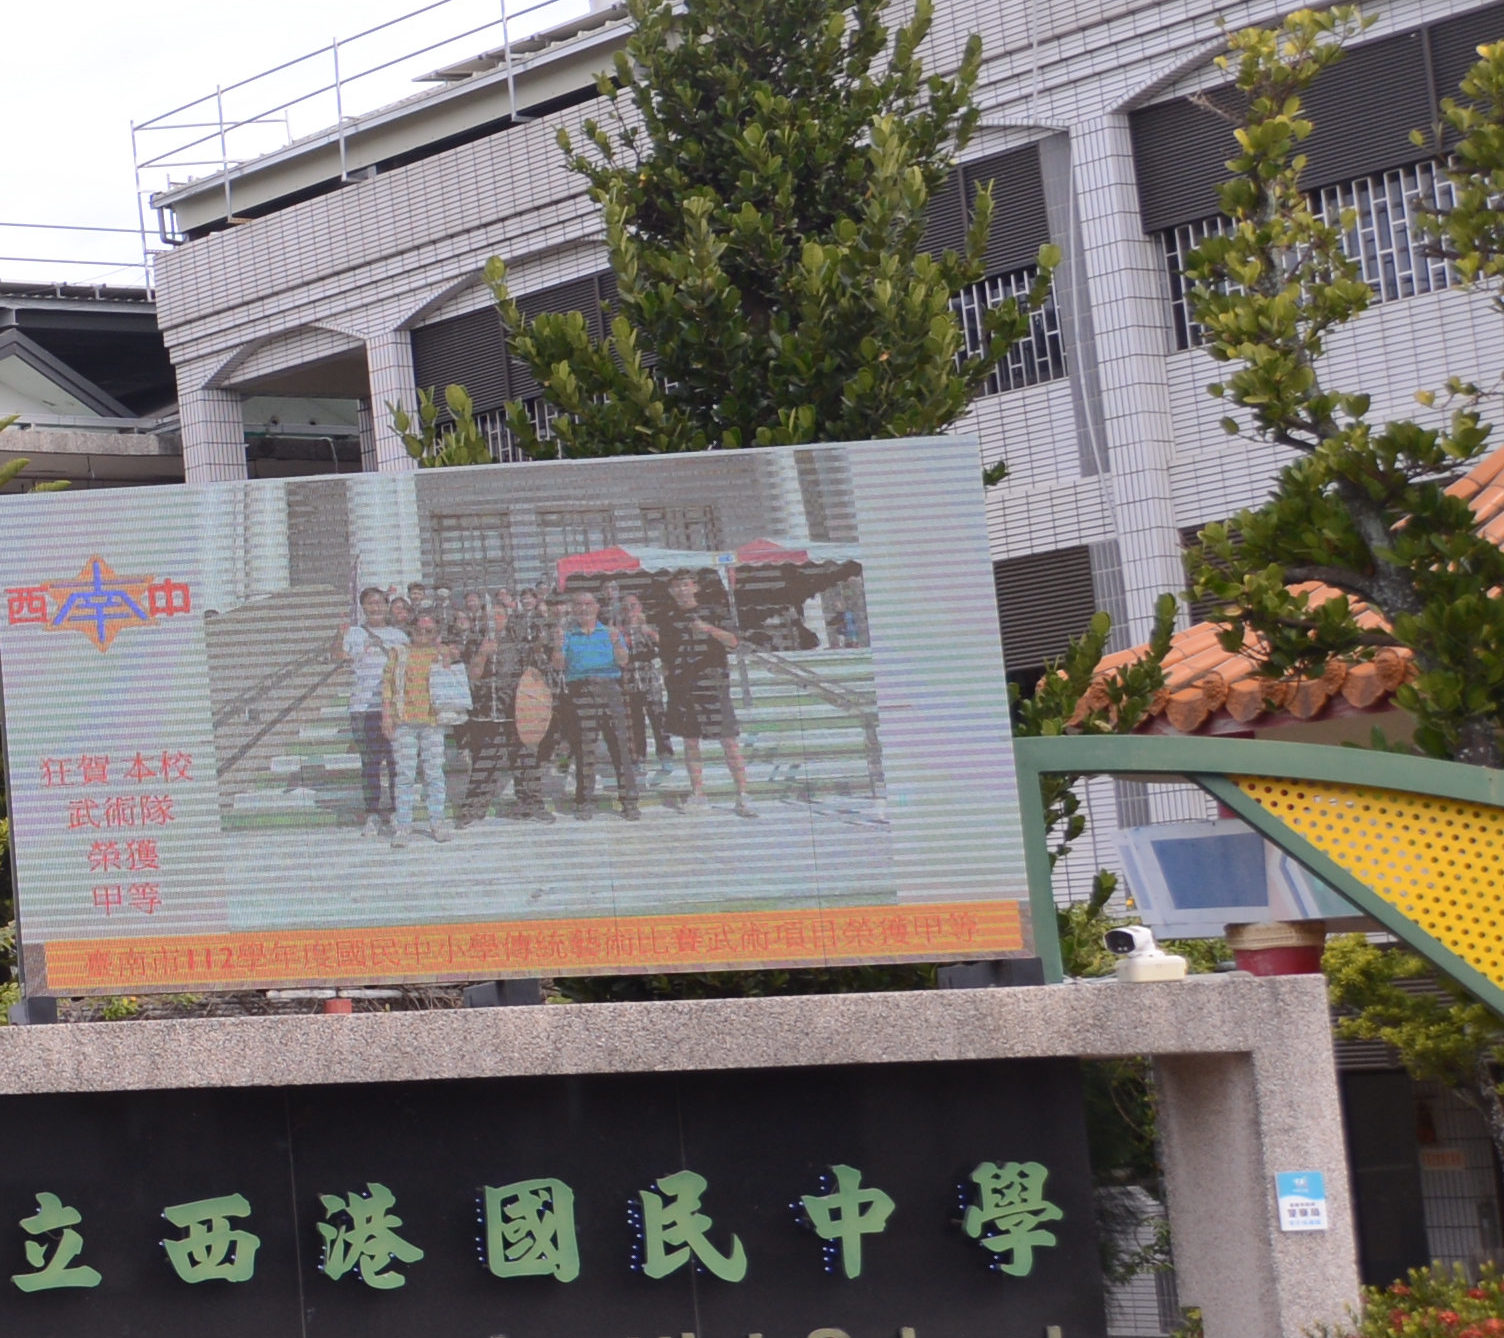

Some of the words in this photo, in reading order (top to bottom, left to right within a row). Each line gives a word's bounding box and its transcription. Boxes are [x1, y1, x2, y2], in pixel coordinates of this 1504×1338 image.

[4, 585, 50, 625] 西
[148, 578, 191, 618] 中
[41, 754, 110, 788] 狂賀
[123, 750, 193, 784] 本校
[68, 794, 176, 830] 武術隊
[87, 838, 160, 872] 榮獲
[92, 882, 162, 916] 甲等
